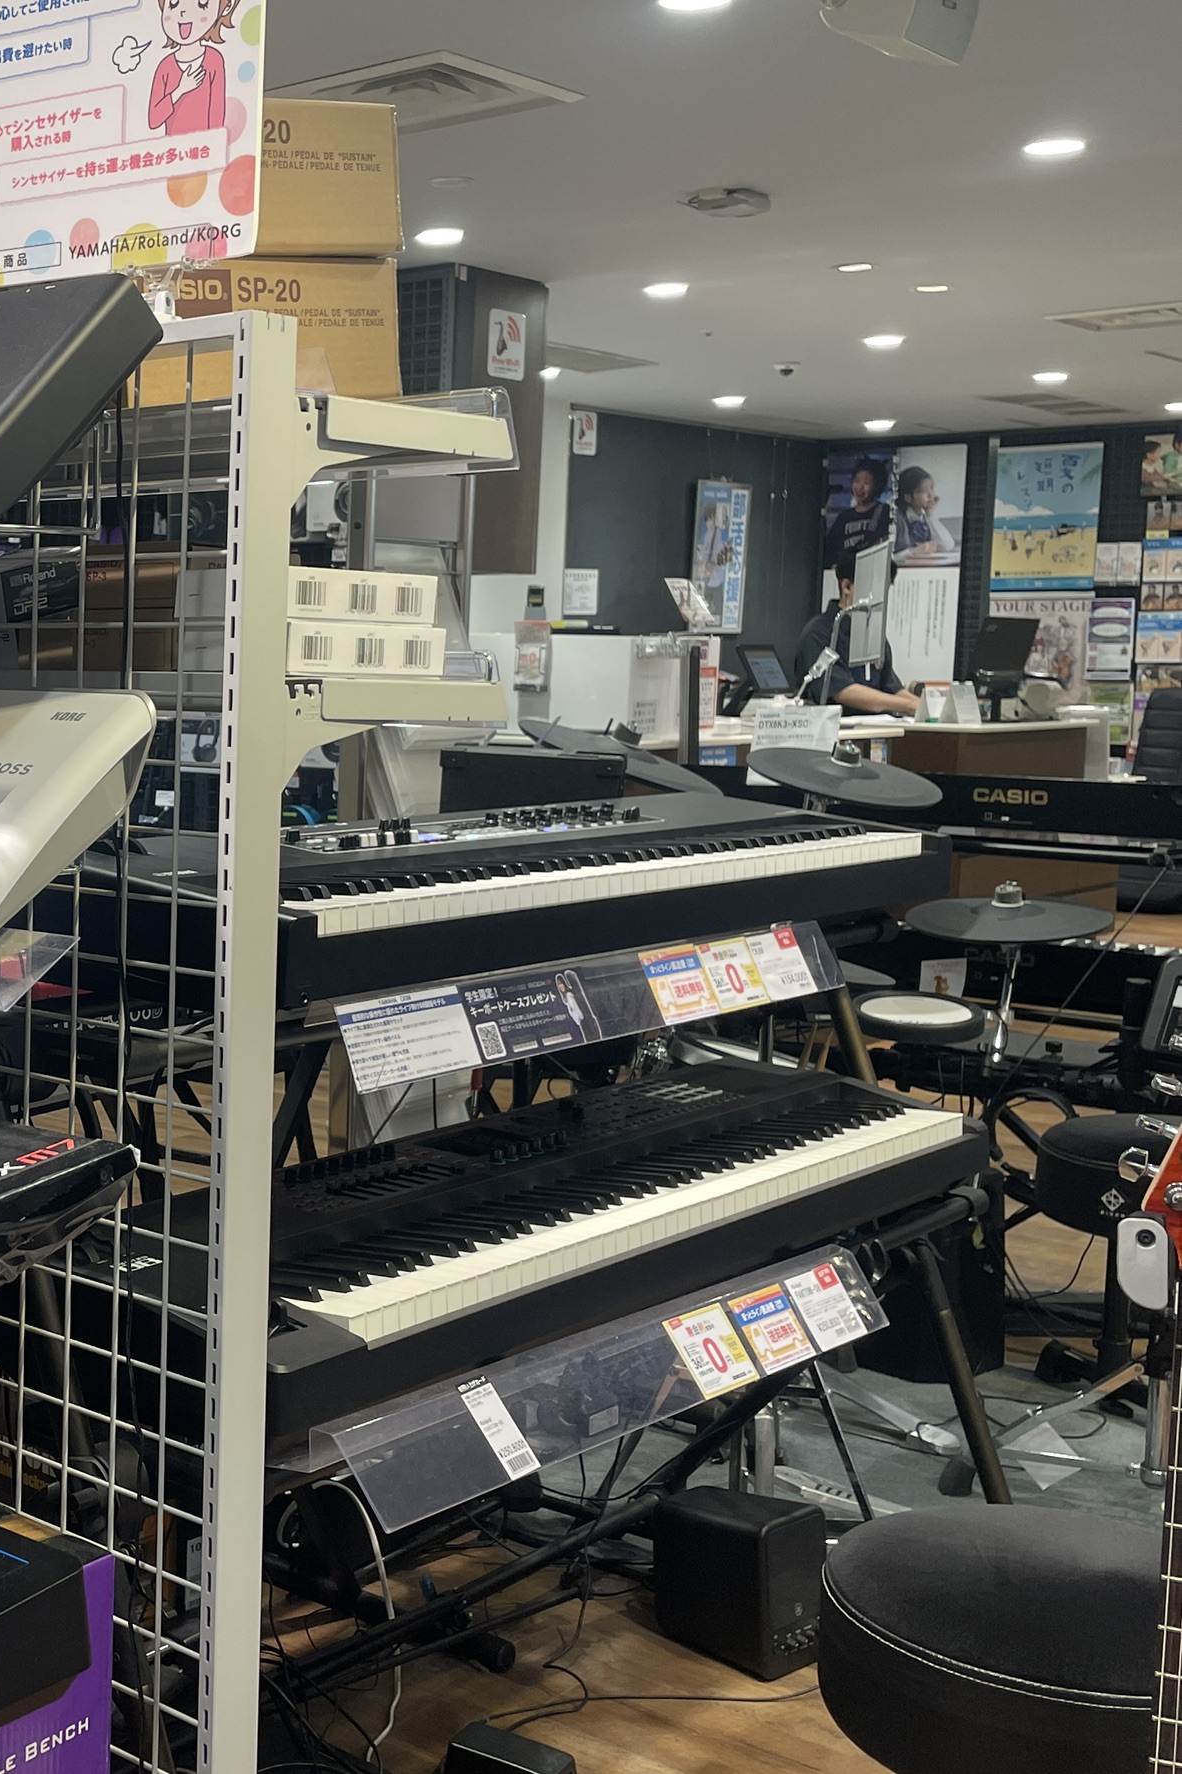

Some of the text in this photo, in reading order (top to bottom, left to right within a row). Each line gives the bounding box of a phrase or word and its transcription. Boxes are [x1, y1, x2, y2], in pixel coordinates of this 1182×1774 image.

[10, 130, 72, 152] 購入される時
[324, 152, 334, 160] DE
[11, 146, 211, 189] シンセサイザーを持ち運ぶ機会が多い場合
[344, 163, 381, 172] DE TENUE
[68, 223, 242, 260] YAMAHA/Roland/KORG
[237, 276, 302, 303] SP-20
[331, 309, 341, 317] DE
[350, 319, 385, 327] DE TENUE
[994, 601, 1035, 613] YOUR
[50, 711, 87, 722] KORG
[972, 786, 1049, 806] CASIO
[675, 980, 705, 998] 送料無料
[470, 990, 557, 1017] キーボードケースプレゼント
[25, 1717, 89, 1762] BENCH
